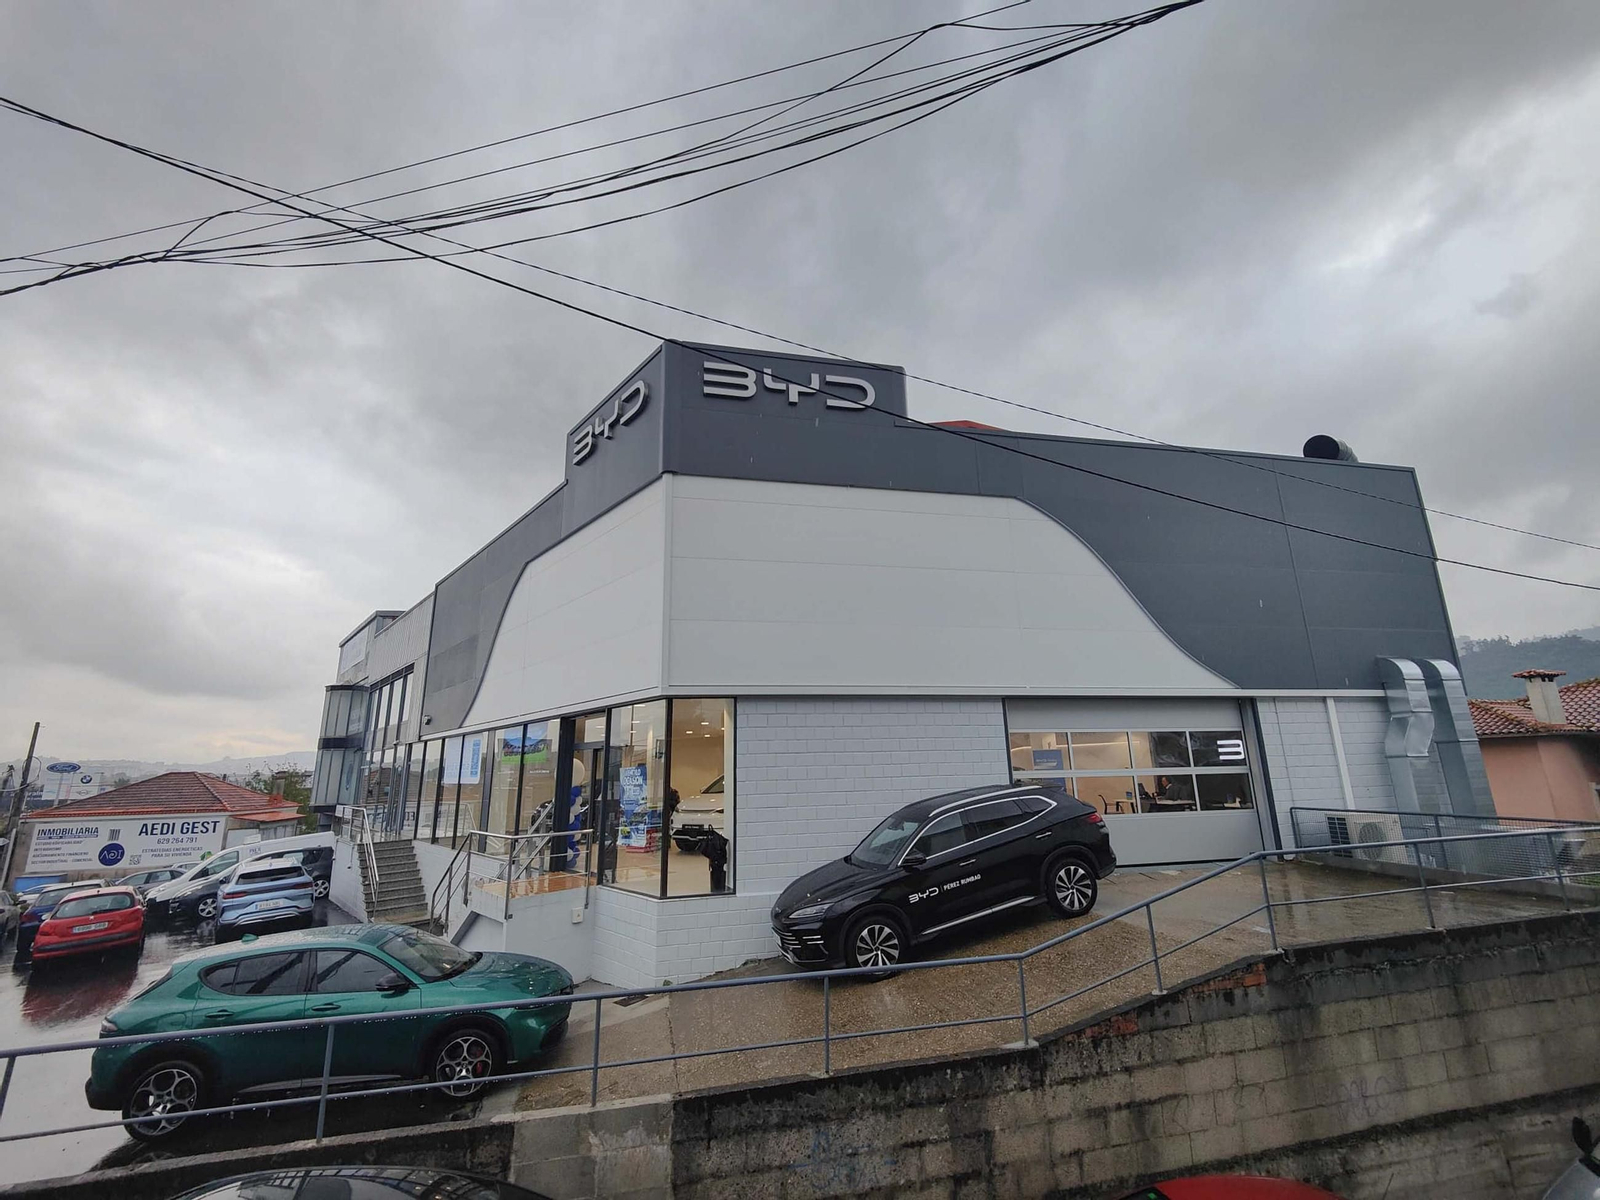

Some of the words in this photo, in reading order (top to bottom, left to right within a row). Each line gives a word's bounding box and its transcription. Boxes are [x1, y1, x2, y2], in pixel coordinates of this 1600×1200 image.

[703, 361, 876, 409] BYD
[572, 380, 648, 466] BYD
[37, 827, 99, 837] INMOBILIARIA
[138, 822, 176, 836] AEDI
[180, 821, 220, 834] GEST
[908, 887, 939, 904] BYD
